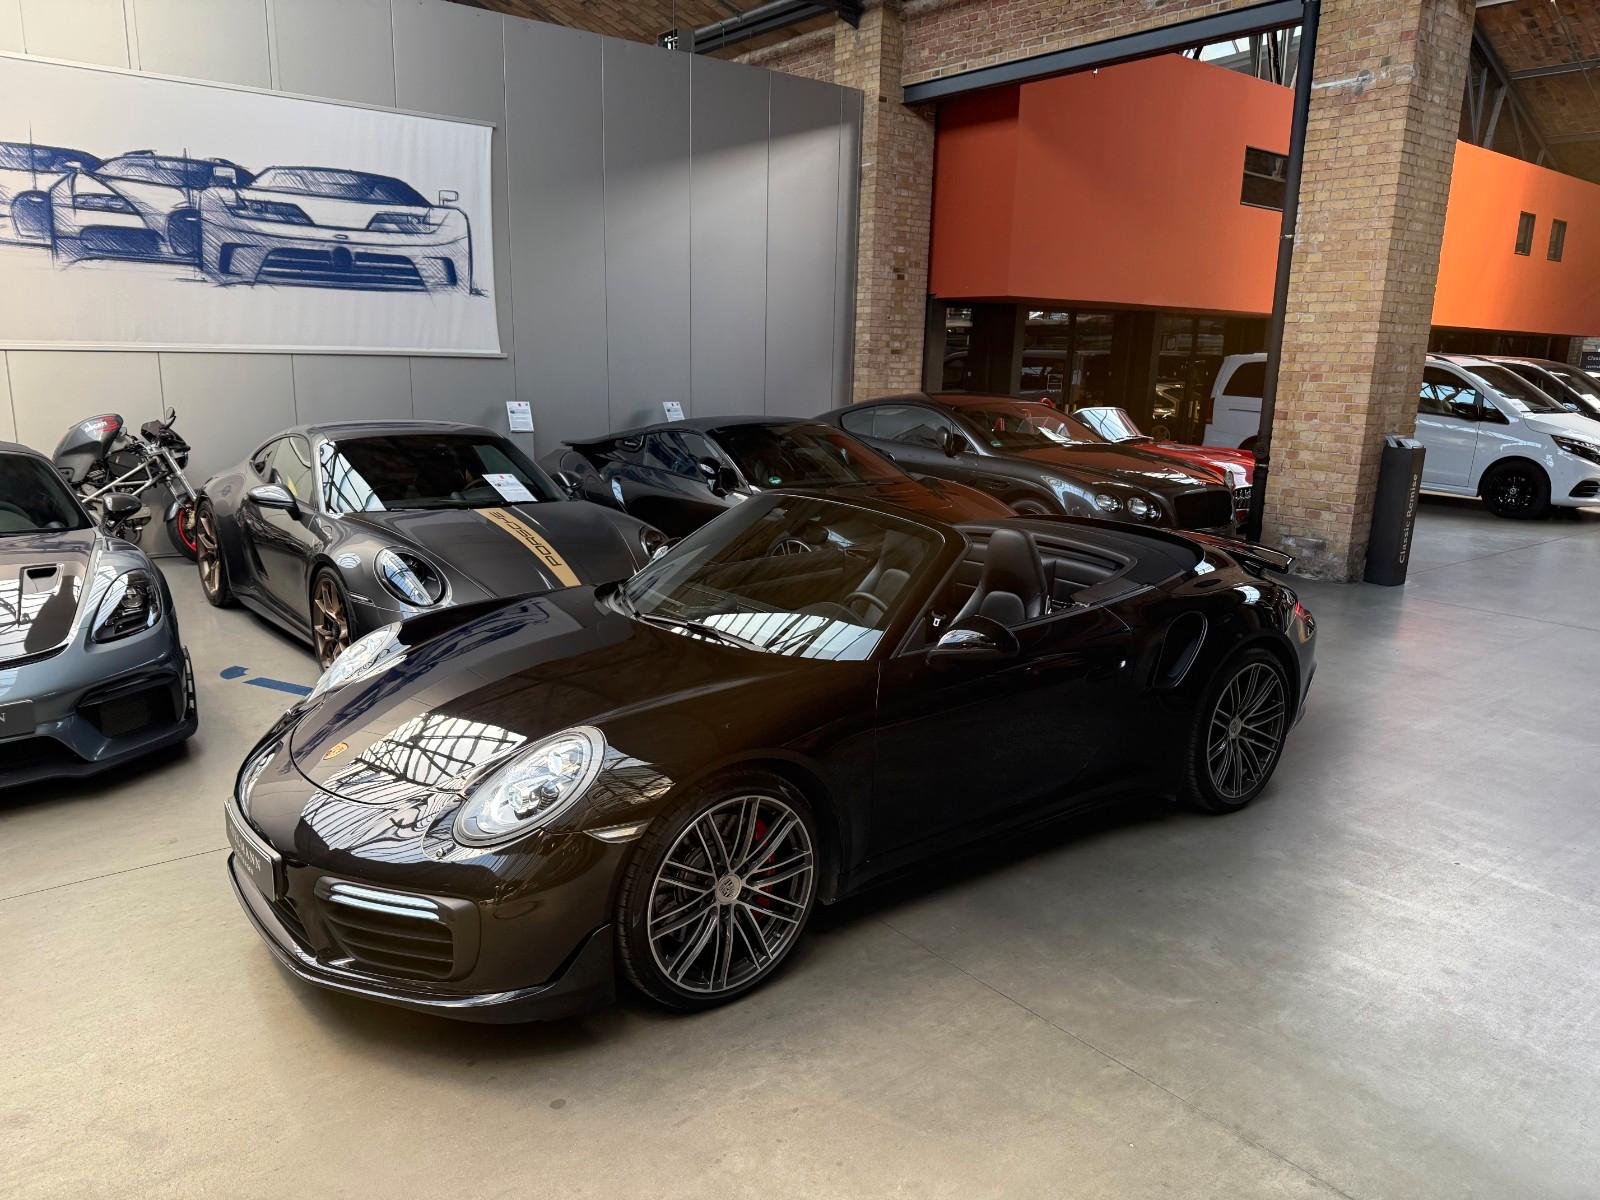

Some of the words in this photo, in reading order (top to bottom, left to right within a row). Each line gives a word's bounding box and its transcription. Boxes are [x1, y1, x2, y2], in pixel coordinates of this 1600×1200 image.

[489, 511, 562, 566] PORSCHE
[1399, 520, 1411, 564] Classic
[1406, 473, 1418, 517] Remise
